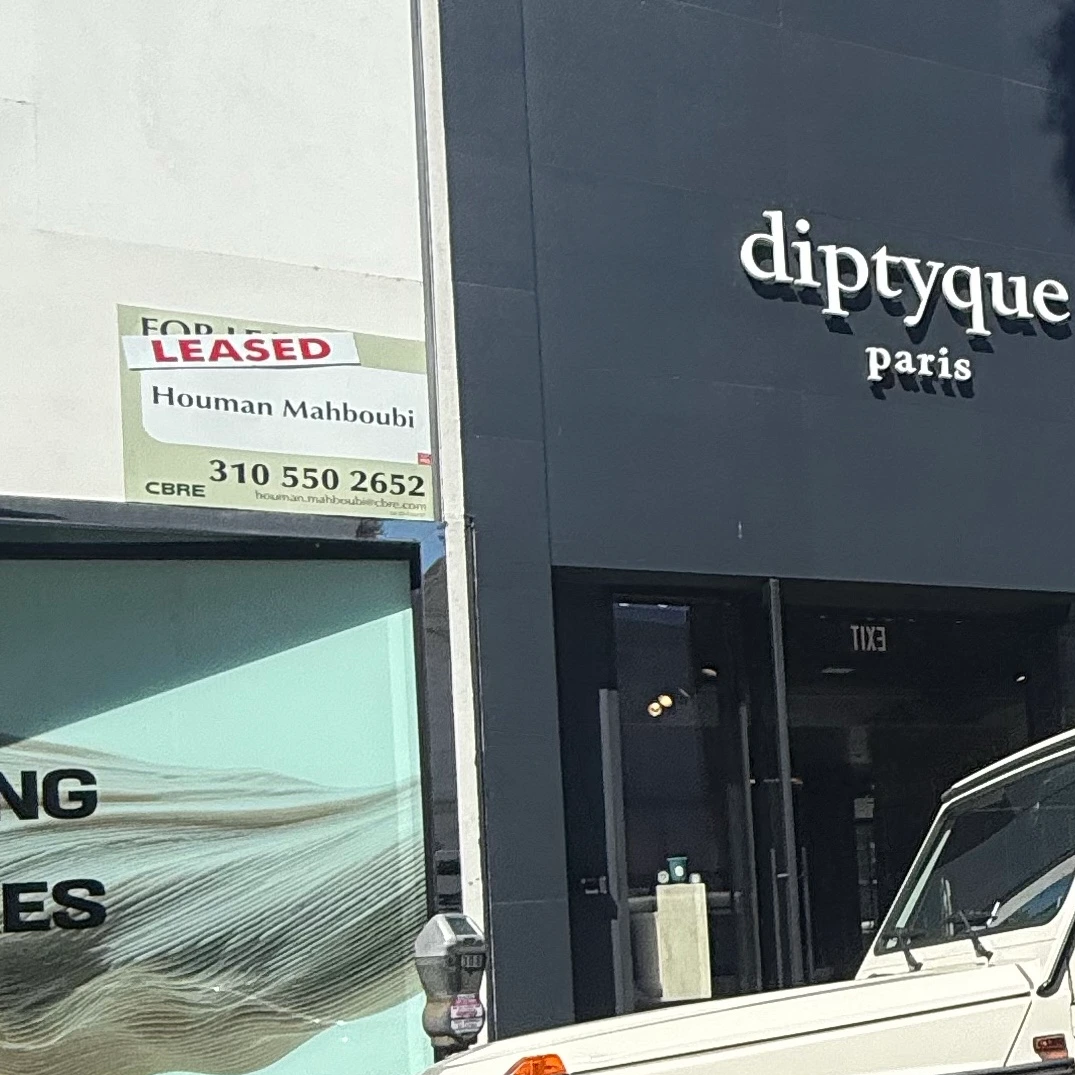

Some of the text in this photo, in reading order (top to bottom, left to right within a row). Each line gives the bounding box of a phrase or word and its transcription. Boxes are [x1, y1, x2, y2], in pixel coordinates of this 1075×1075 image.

[740, 210, 1071, 336] diptyque
[151, 338, 331, 362] LEASED
[865, 346, 972, 382] paris
[152, 386, 415, 429] Houman Mahboubi
[145, 481, 206, 498] CBRE
[209, 459, 425, 497] 310 550 2652
[2, 879, 107, 932] ES
